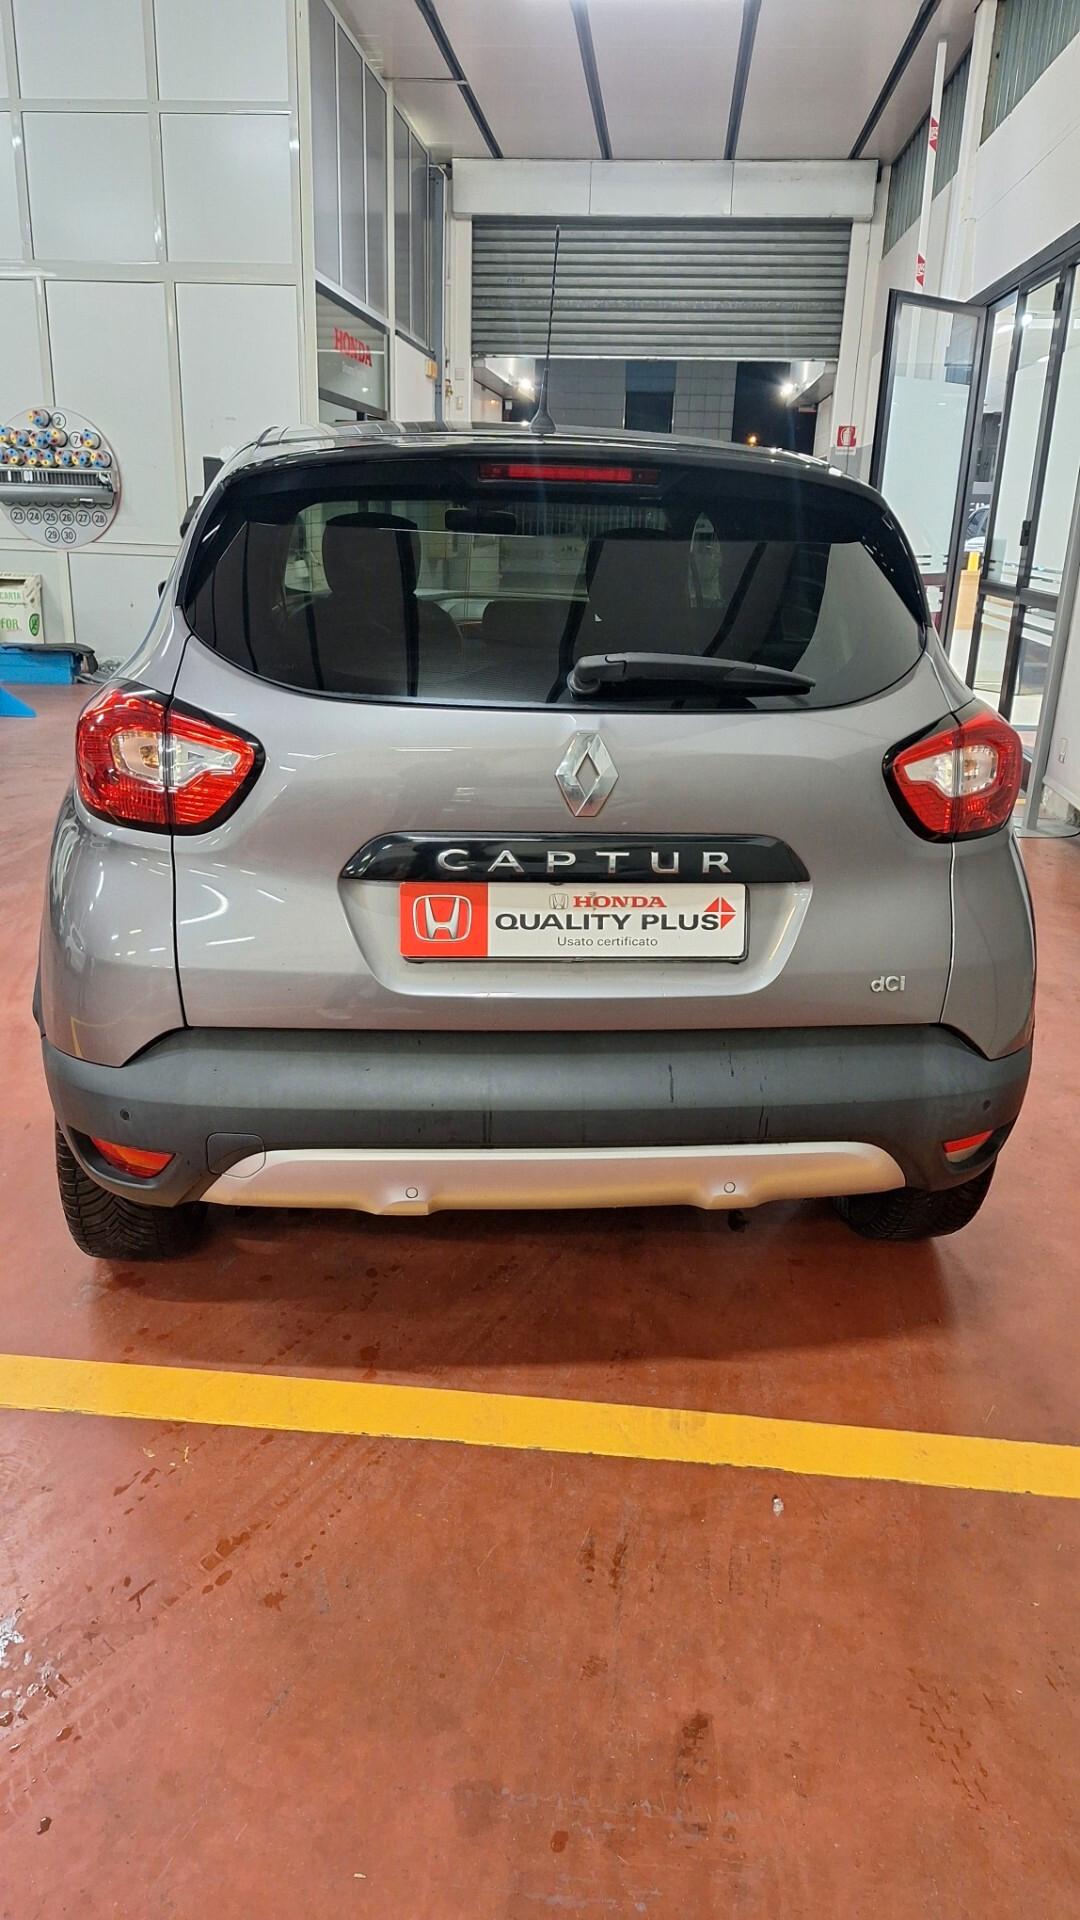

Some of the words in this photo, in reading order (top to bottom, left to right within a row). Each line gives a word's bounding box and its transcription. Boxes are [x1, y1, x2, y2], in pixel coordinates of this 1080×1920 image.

[334, 327, 372, 367] HONDA
[55, 416, 62, 426] 2
[73, 435, 79, 445] 7
[29, 512, 39, 521] 24
[46, 514, 56, 522] 25
[47, 530, 57, 539] 29
[64, 531, 74, 539] 30
[437, 849, 732, 874] CAPTUR
[573, 895, 667, 908] HONDA
[494, 913, 632, 931] QUALITY
[641, 913, 719, 931] PLUS
[557, 936, 594, 947] Usato
[597, 936, 658, 947] certificato
